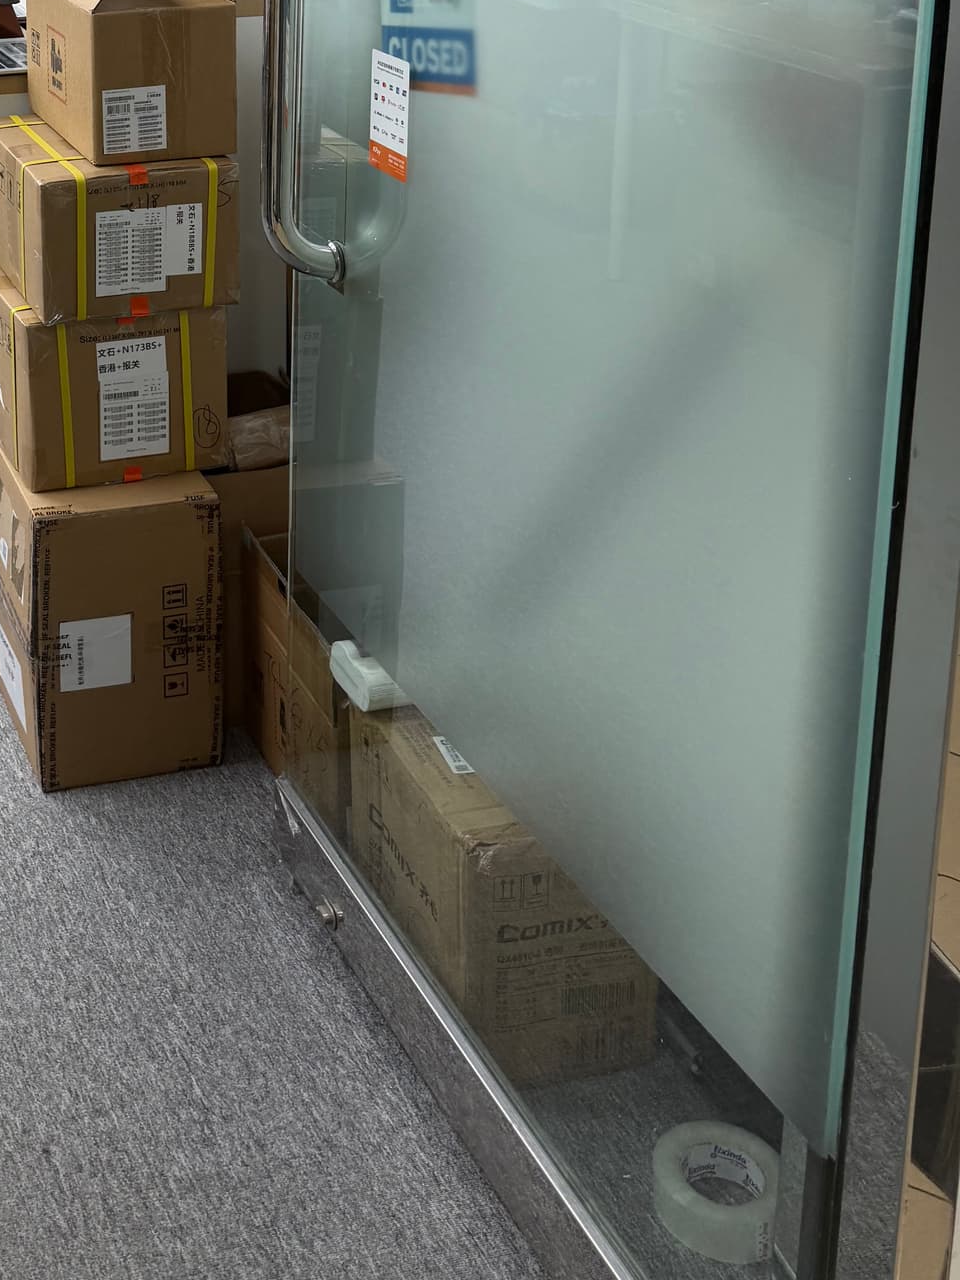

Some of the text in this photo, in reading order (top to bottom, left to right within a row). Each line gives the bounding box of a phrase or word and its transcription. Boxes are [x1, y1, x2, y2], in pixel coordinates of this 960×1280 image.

[388, 36, 467, 76] CLOSED
[98, 341, 162, 359] 文石+N173BS+
[99, 360, 141, 374] 香港+报关
[368, 801, 417, 887] Comix
[496, 916, 593, 943] Comix
